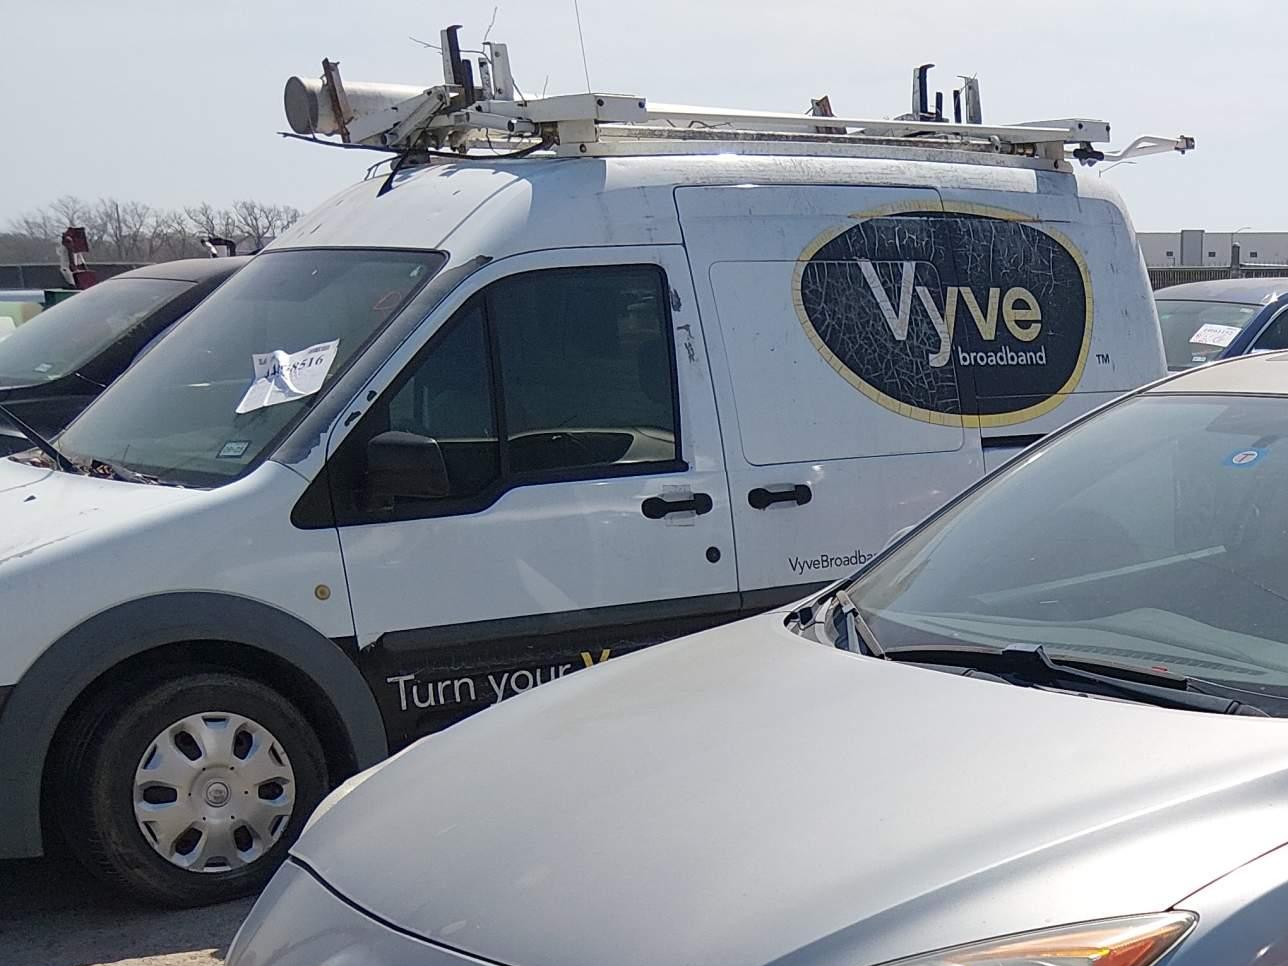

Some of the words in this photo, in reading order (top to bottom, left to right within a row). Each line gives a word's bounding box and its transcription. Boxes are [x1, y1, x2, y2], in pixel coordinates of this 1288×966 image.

[857, 260, 1042, 368] Vyve
[958, 346, 1047, 366] broadband
[1096, 354, 1110, 365] TM
[788, 549, 878, 575] VyveBroadba
[386, 674, 476, 711] Turn
